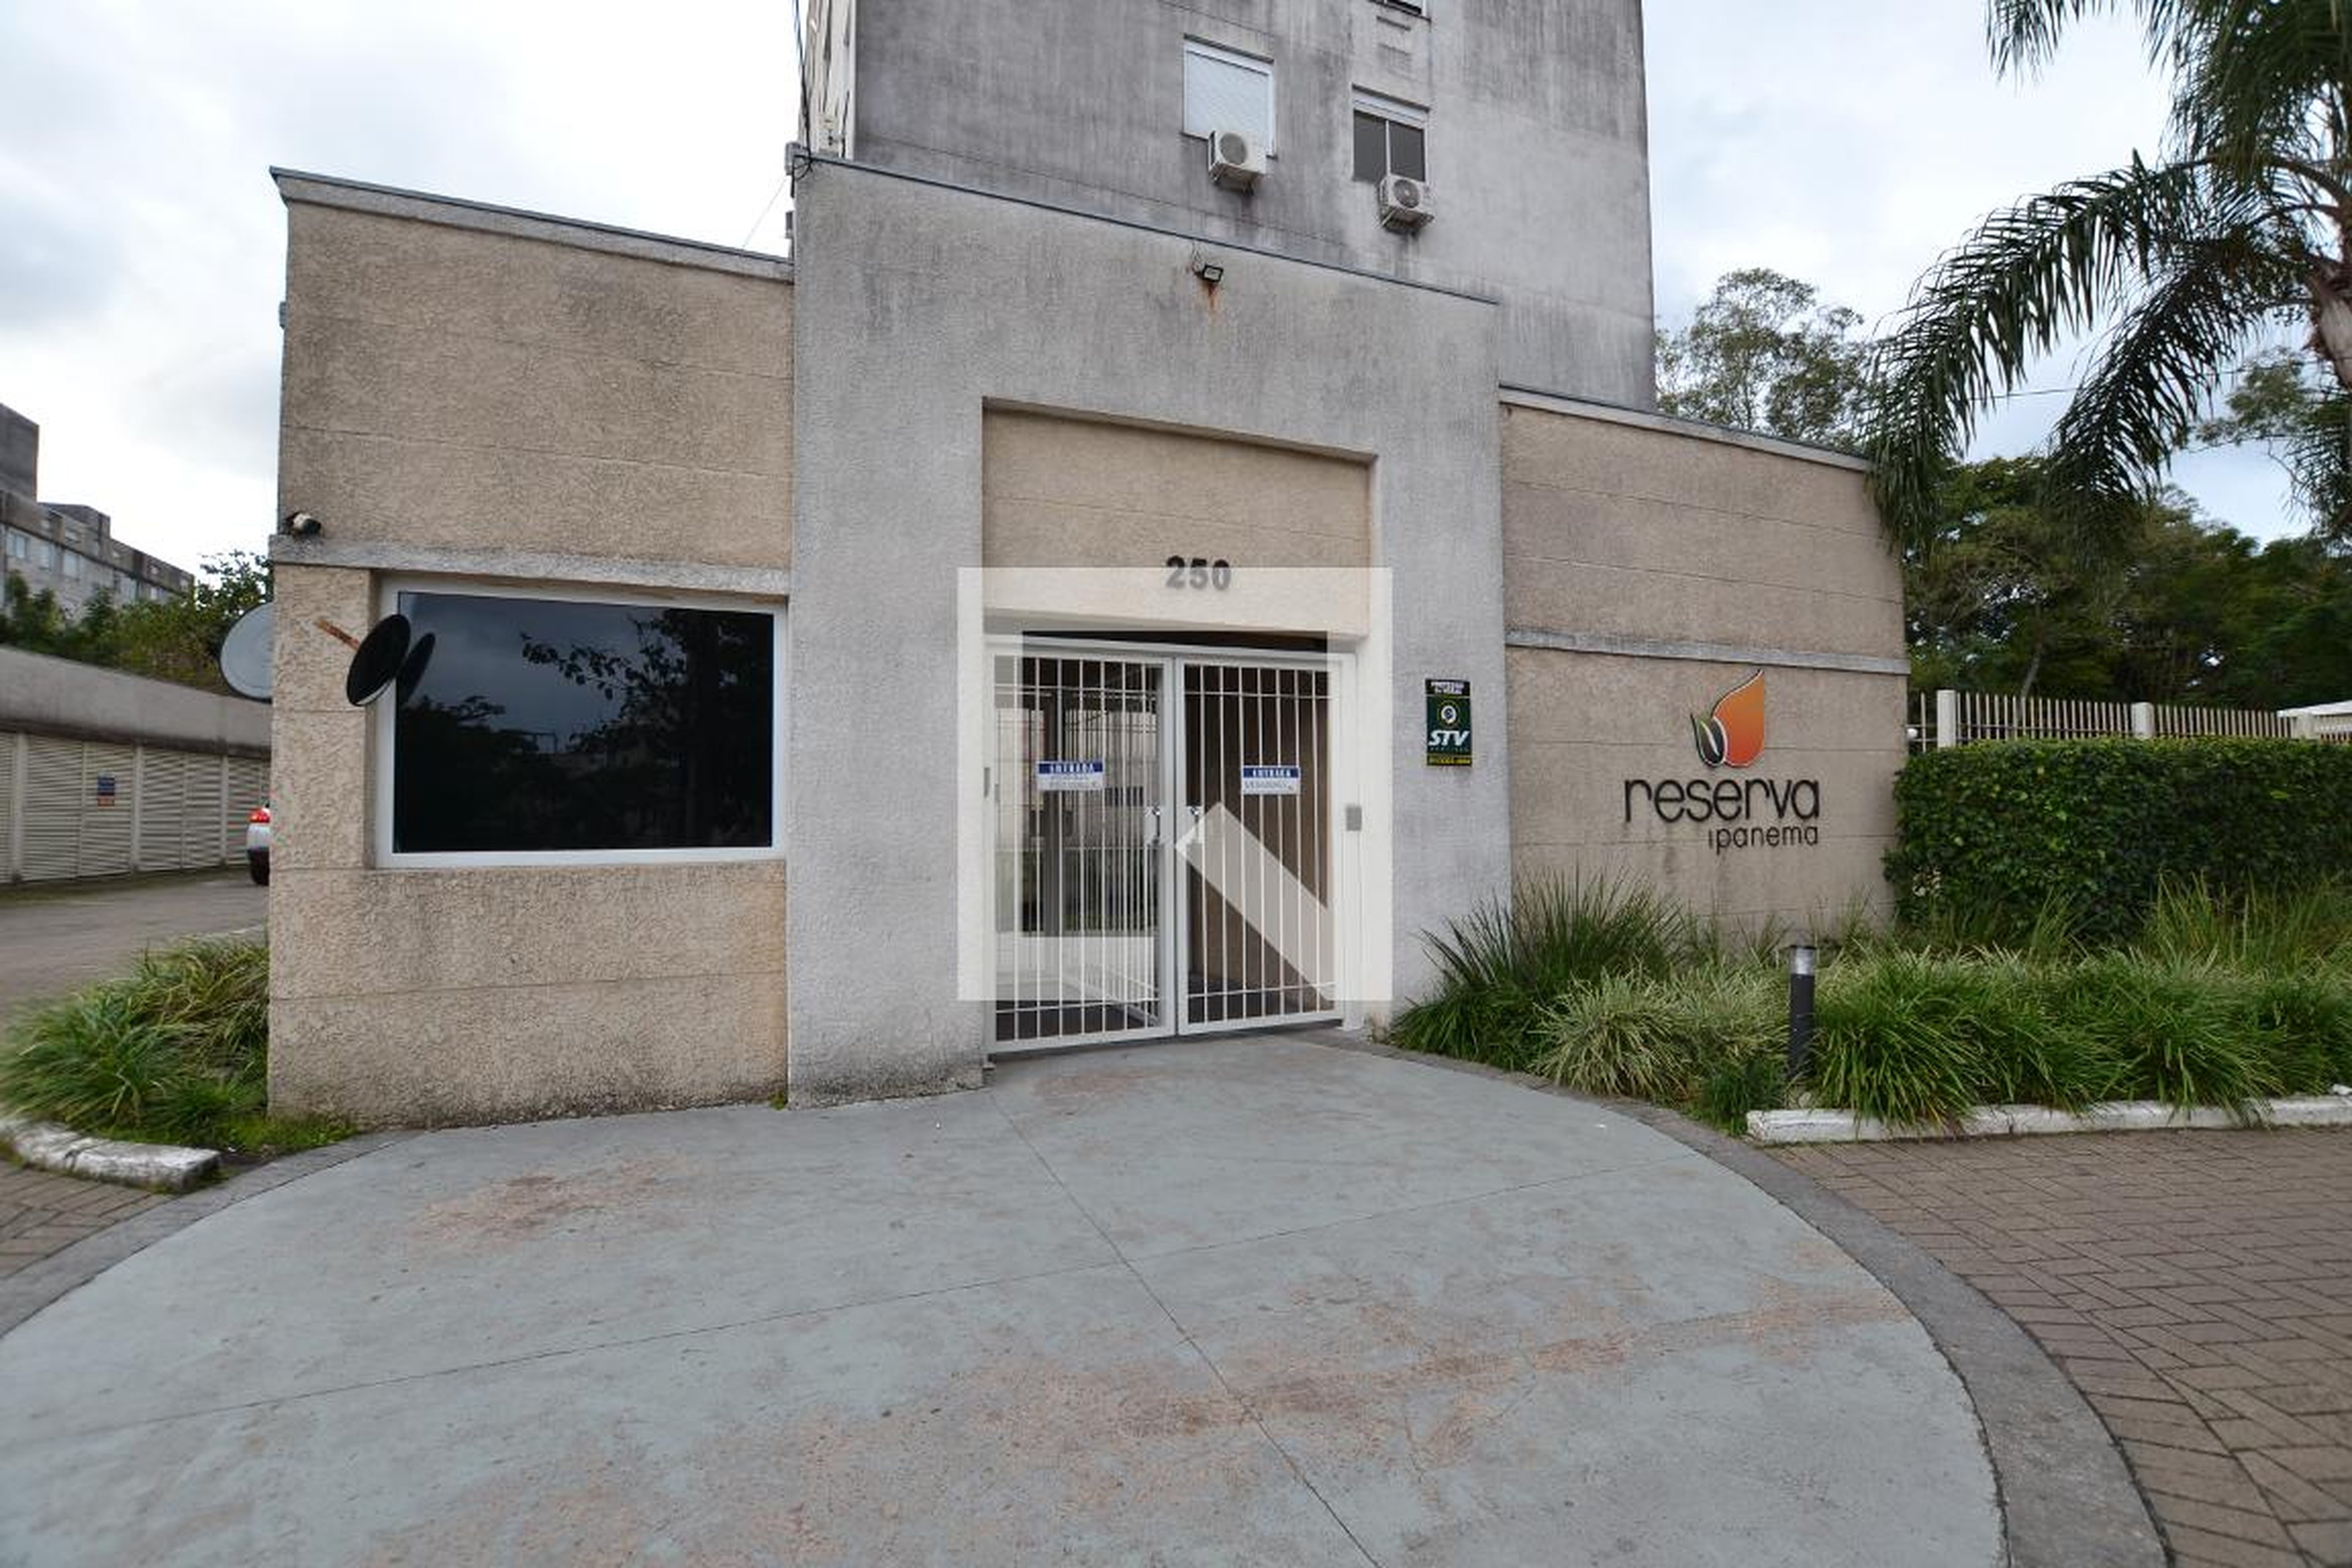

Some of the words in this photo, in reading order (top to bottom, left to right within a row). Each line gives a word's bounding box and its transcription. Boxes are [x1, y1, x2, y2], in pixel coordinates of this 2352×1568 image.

[1166, 555, 1231, 590] 250
[1428, 730, 1471, 746] STV
[1624, 779, 1820, 823] reserva
[1708, 826, 1819, 855] ipanema
